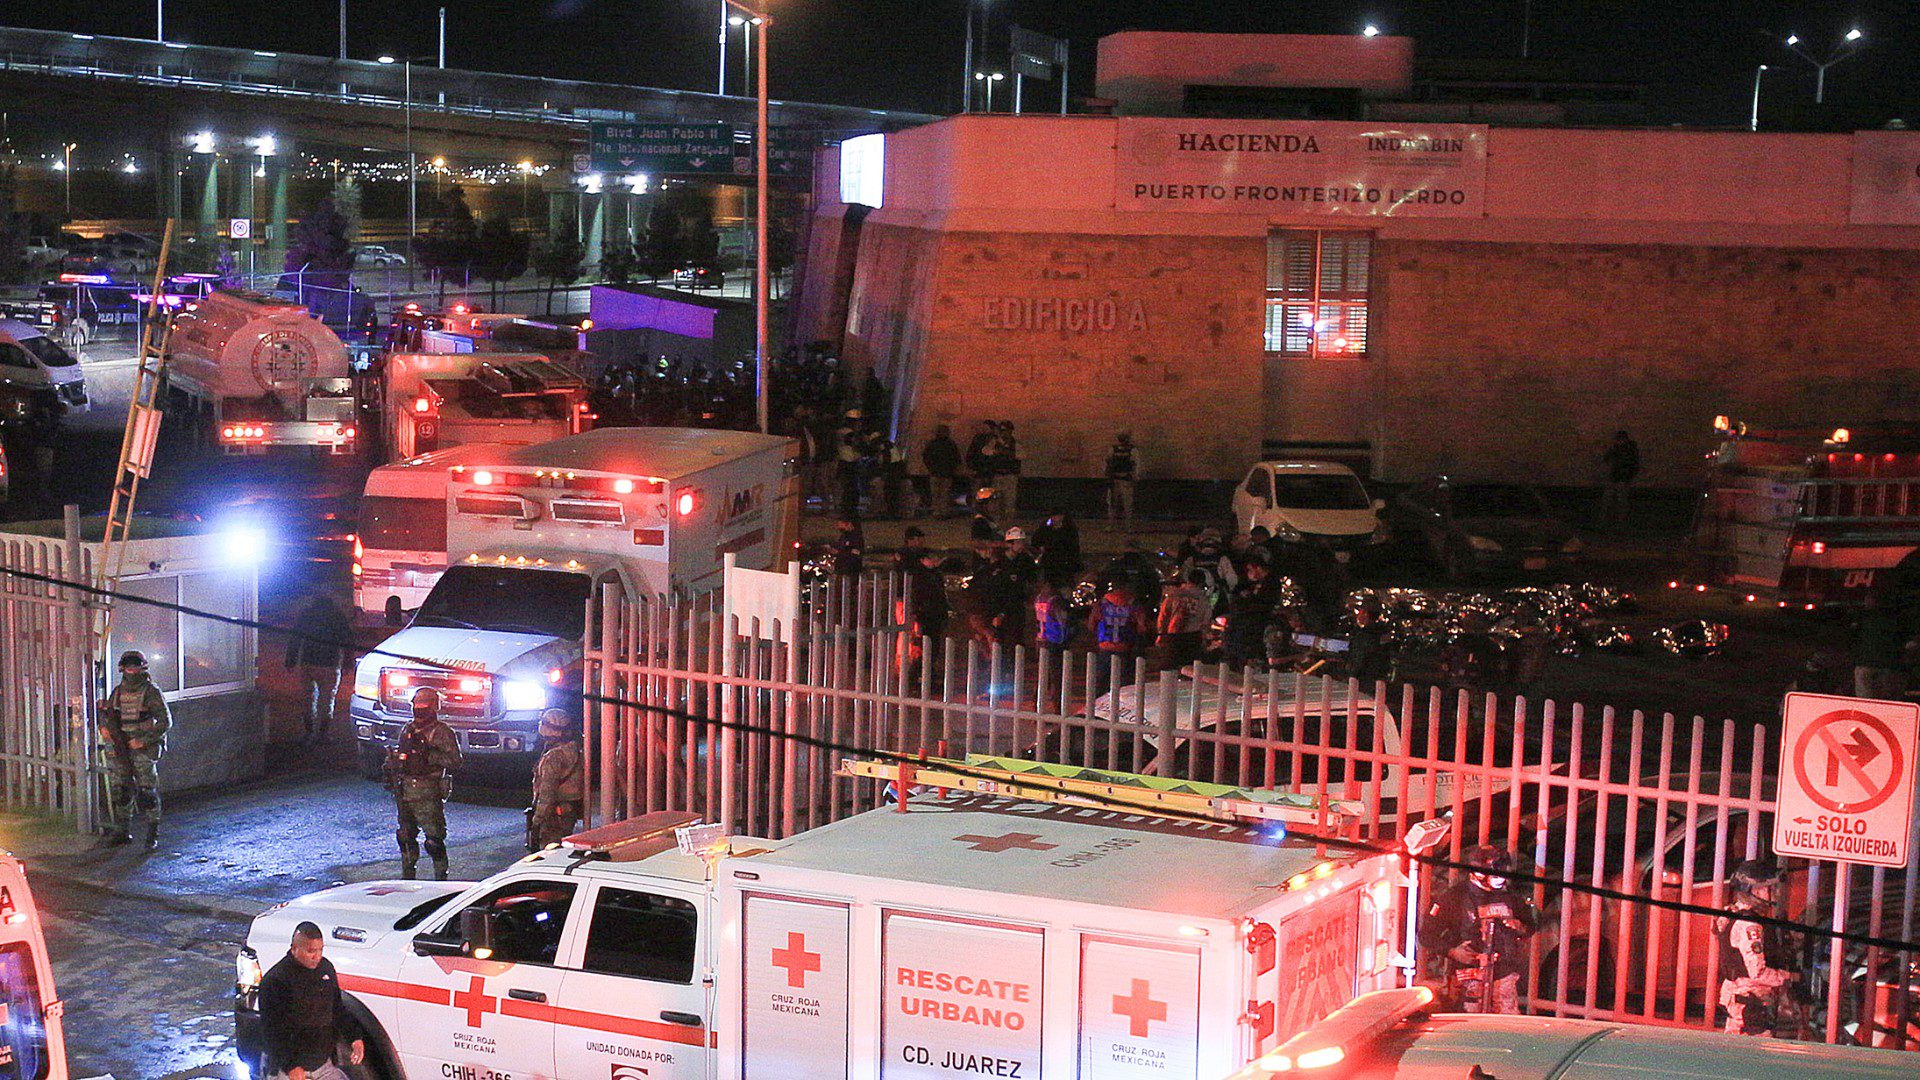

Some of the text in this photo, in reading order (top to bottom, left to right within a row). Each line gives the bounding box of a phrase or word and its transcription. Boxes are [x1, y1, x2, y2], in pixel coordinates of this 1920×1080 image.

[639, 128, 668, 138] Juan
[672, 128, 704, 139] Pablo
[1177, 133, 1320, 153] HACIENDA
[1134, 184, 1466, 205] PUERTO FRONTERIZO LERDO
[984, 298, 1150, 331] EDIFICIO A
[1816, 815, 1868, 835] SOLO
[1784, 830, 1897, 857] VUELTA IZQUIERDA
[897, 967, 1030, 1003] RESCATE
[771, 994, 820, 1007] CRUZ ROJA
[772, 1003, 820, 1017] MEXICANA
[901, 996, 1025, 1031] URBANO
[453, 1032, 496, 1045] CRUZ ROJA
[454, 1041, 496, 1054] MEXICANA
[586, 1041, 675, 1065] UNIDAD DONADA POR:
[1111, 1044, 1166, 1059] CRUZ ROJA
[1112, 1054, 1165, 1069] MEXICANA
[441, 1063, 476, 1080] CHIH
[902, 1045, 1022, 1079] CD. JUAREZ
